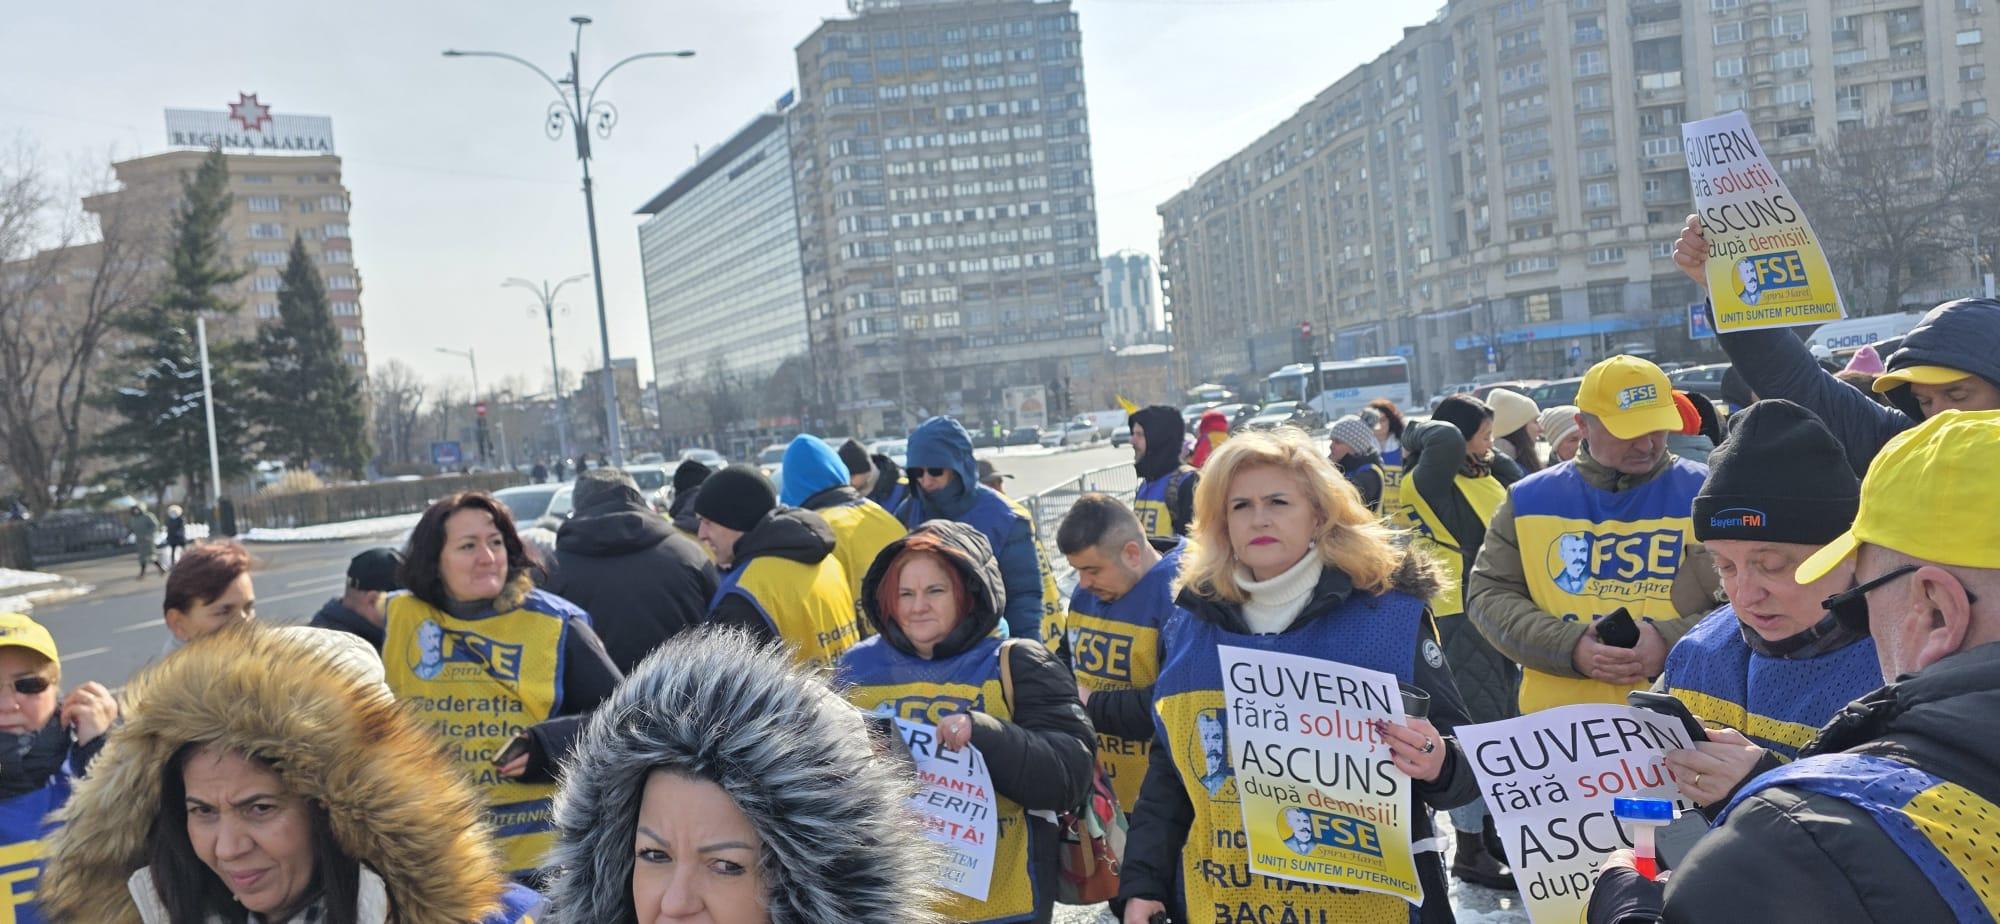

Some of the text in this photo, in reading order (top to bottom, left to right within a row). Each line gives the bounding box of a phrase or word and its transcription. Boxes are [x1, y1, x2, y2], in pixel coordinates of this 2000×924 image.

[173, 132, 328, 150] REGINA MARIA
[1685, 127, 1757, 168] GUVERN
[1712, 162, 1780, 195] soluții,
[1698, 195, 1797, 236] ASCUNS
[1707, 226, 1811, 260] după demisii!
[1753, 255, 1806, 286] FSE
[1720, 311, 1744, 325] UNIȚI
[1746, 307, 1783, 320] SUNTEM
[1826, 332, 1878, 349] CHORUS
[1629, 386, 1657, 400] FSE
[1591, 534, 1678, 578] FSE
[1589, 581, 1669, 595] Spiru Hare
[1076, 632, 1129, 676] FSE
[1230, 662, 1392, 715] GUVERN
[1233, 698, 1289, 732] fără
[1476, 717, 1684, 777] GUVERN
[1241, 740, 1398, 797] ASCUNS
[1244, 777, 1301, 804] după
[1307, 789, 1398, 828] demisii!
[1491, 774, 1569, 813] fără
[1310, 813, 1380, 853] FSE
[1257, 853, 1287, 872] UNIȚI
[1290, 858, 1343, 877] SUNTEM
[1346, 867, 1417, 893] PUTERNICI!
